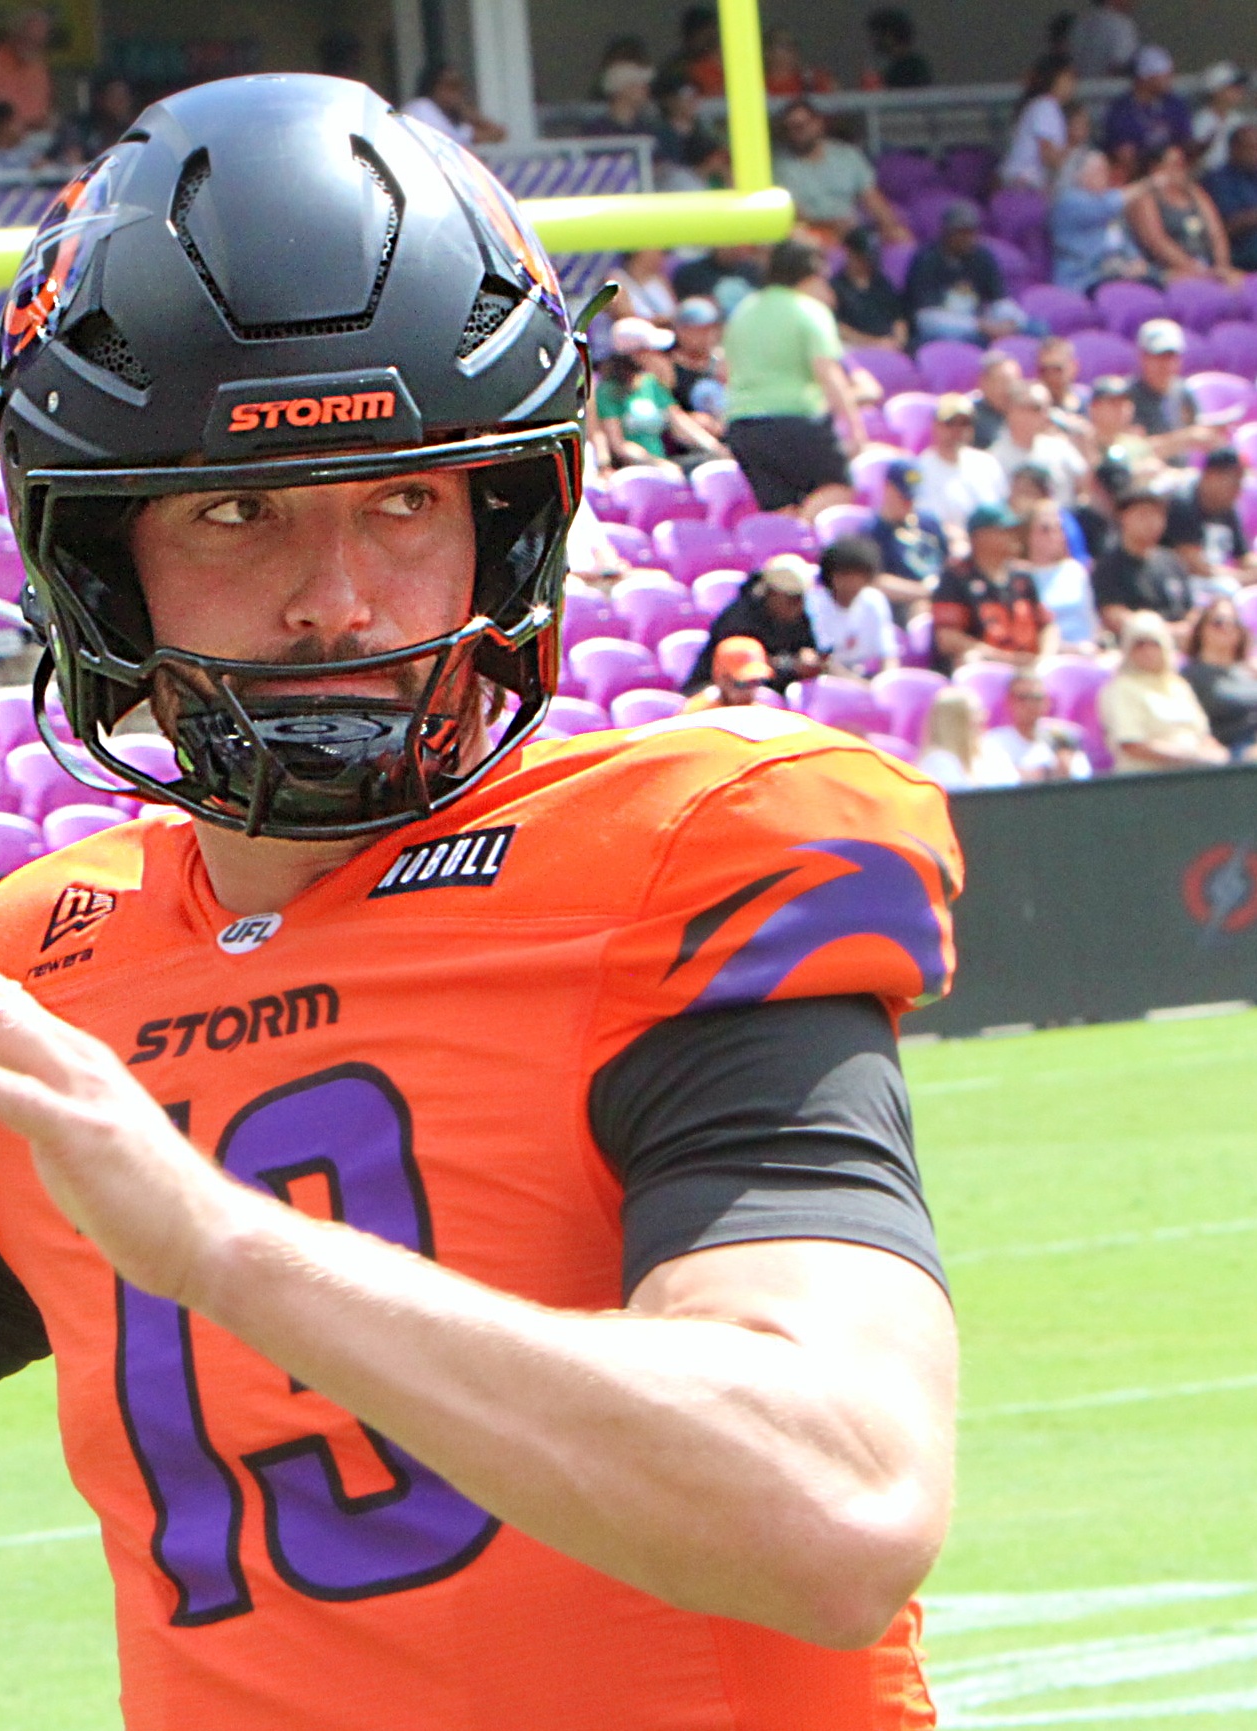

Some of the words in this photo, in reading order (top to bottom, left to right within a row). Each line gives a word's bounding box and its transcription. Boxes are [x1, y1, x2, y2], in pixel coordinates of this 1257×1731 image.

[228, 391, 395, 432] STORM
[377, 834, 506, 889] NOBULL
[221, 920, 273, 943] UFL
[126, 983, 340, 1066] STORM
